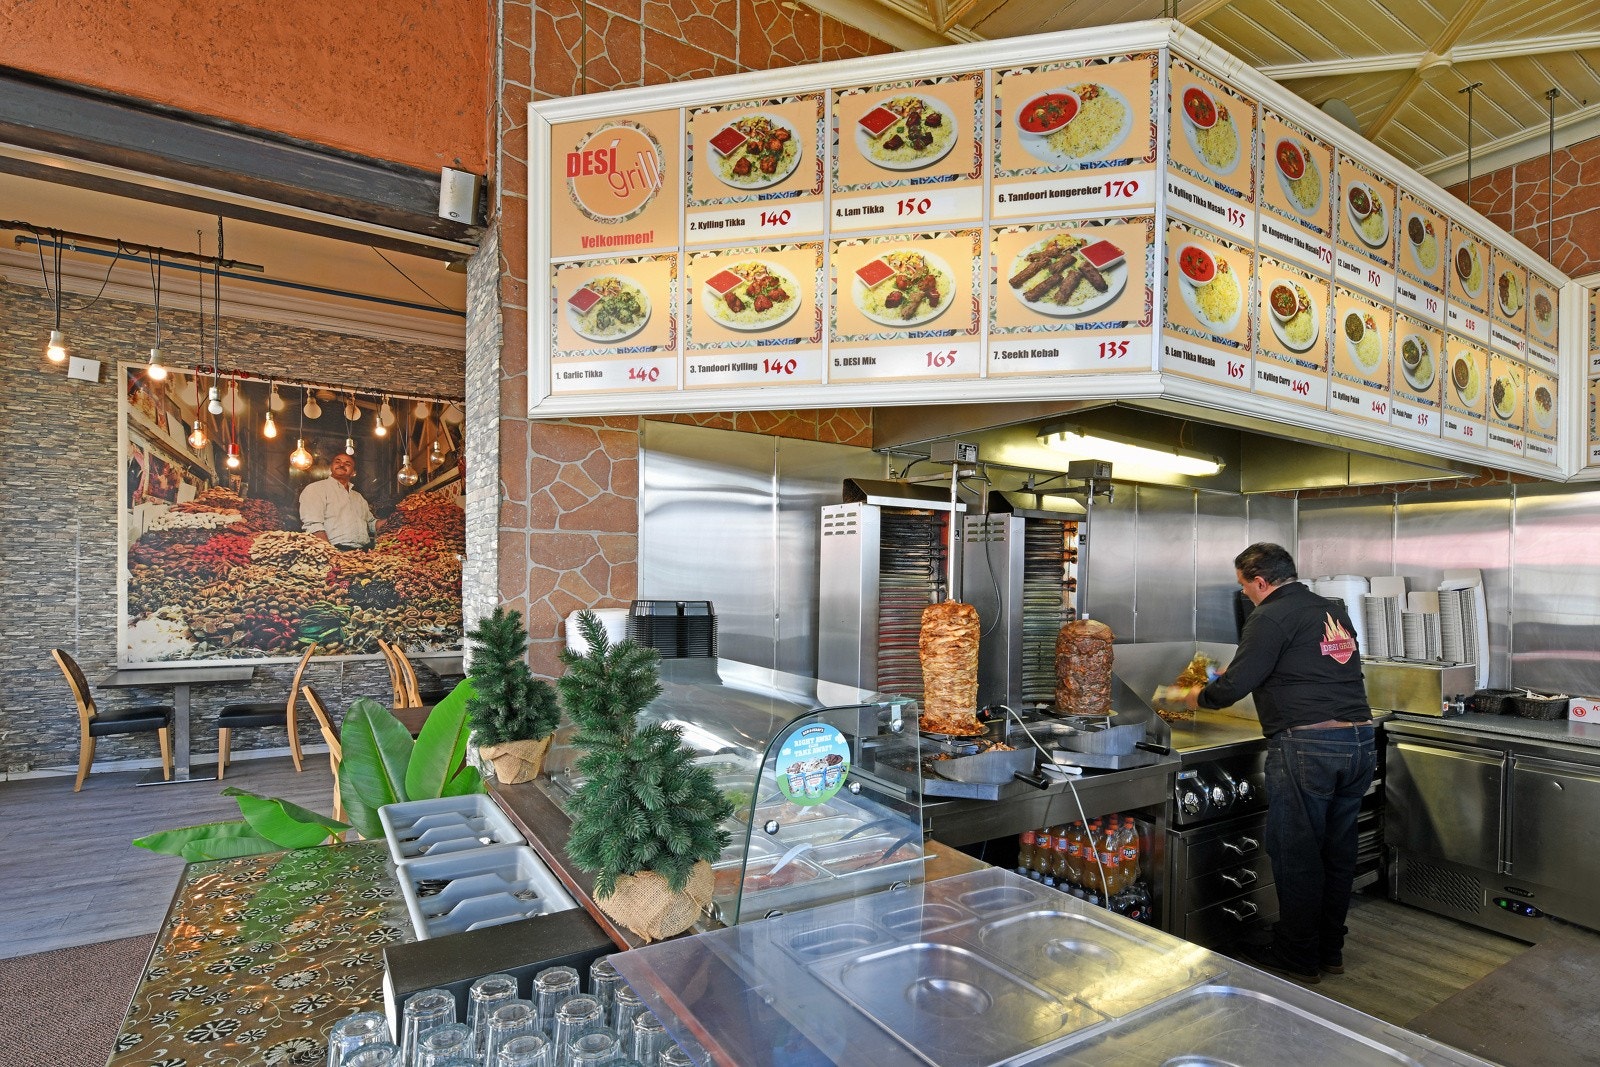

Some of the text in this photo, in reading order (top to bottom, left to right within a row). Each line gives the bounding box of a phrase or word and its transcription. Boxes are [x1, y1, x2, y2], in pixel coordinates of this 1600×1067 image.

[998, 180, 1139, 203] 6. Tandoori kongereker 170
[836, 198, 932, 217] 4. Lam Tikka 150
[1174, 185, 1193, 203] Kylling
[1192, 194, 1207, 208] Tikka
[1207, 200, 1226, 216] Masala
[1227, 207, 1246, 228] 155
[690, 209, 791, 231] 2. Kylling Tikka 140
[581, 230, 654, 249] Velkommen!
[1294, 237, 1305, 249] Tikka
[1318, 246, 1332, 264] 170
[1368, 269, 1381, 287] 150
[1426, 298, 1437, 313] 150
[834, 350, 958, 368] 5. DESI Mix 165
[993, 340, 1131, 360] 7. Seekh Kebab 135
[690, 358, 797, 375] 3. Tandoori Kylling 140
[1165, 346, 1245, 379] 9. Lam Tikka Masala 165
[556, 366, 660, 383] 1. Garlic Tikka 140
[1263, 371, 1278, 384] Kylling
[1278, 375, 1291, 387] Curry
[1292, 379, 1310, 396] 140
[1371, 400, 1387, 415] 140
[1417, 413, 1429, 427] 135
[794, 737, 815, 747] RIGHT
[794, 749, 812, 757] TAKE
